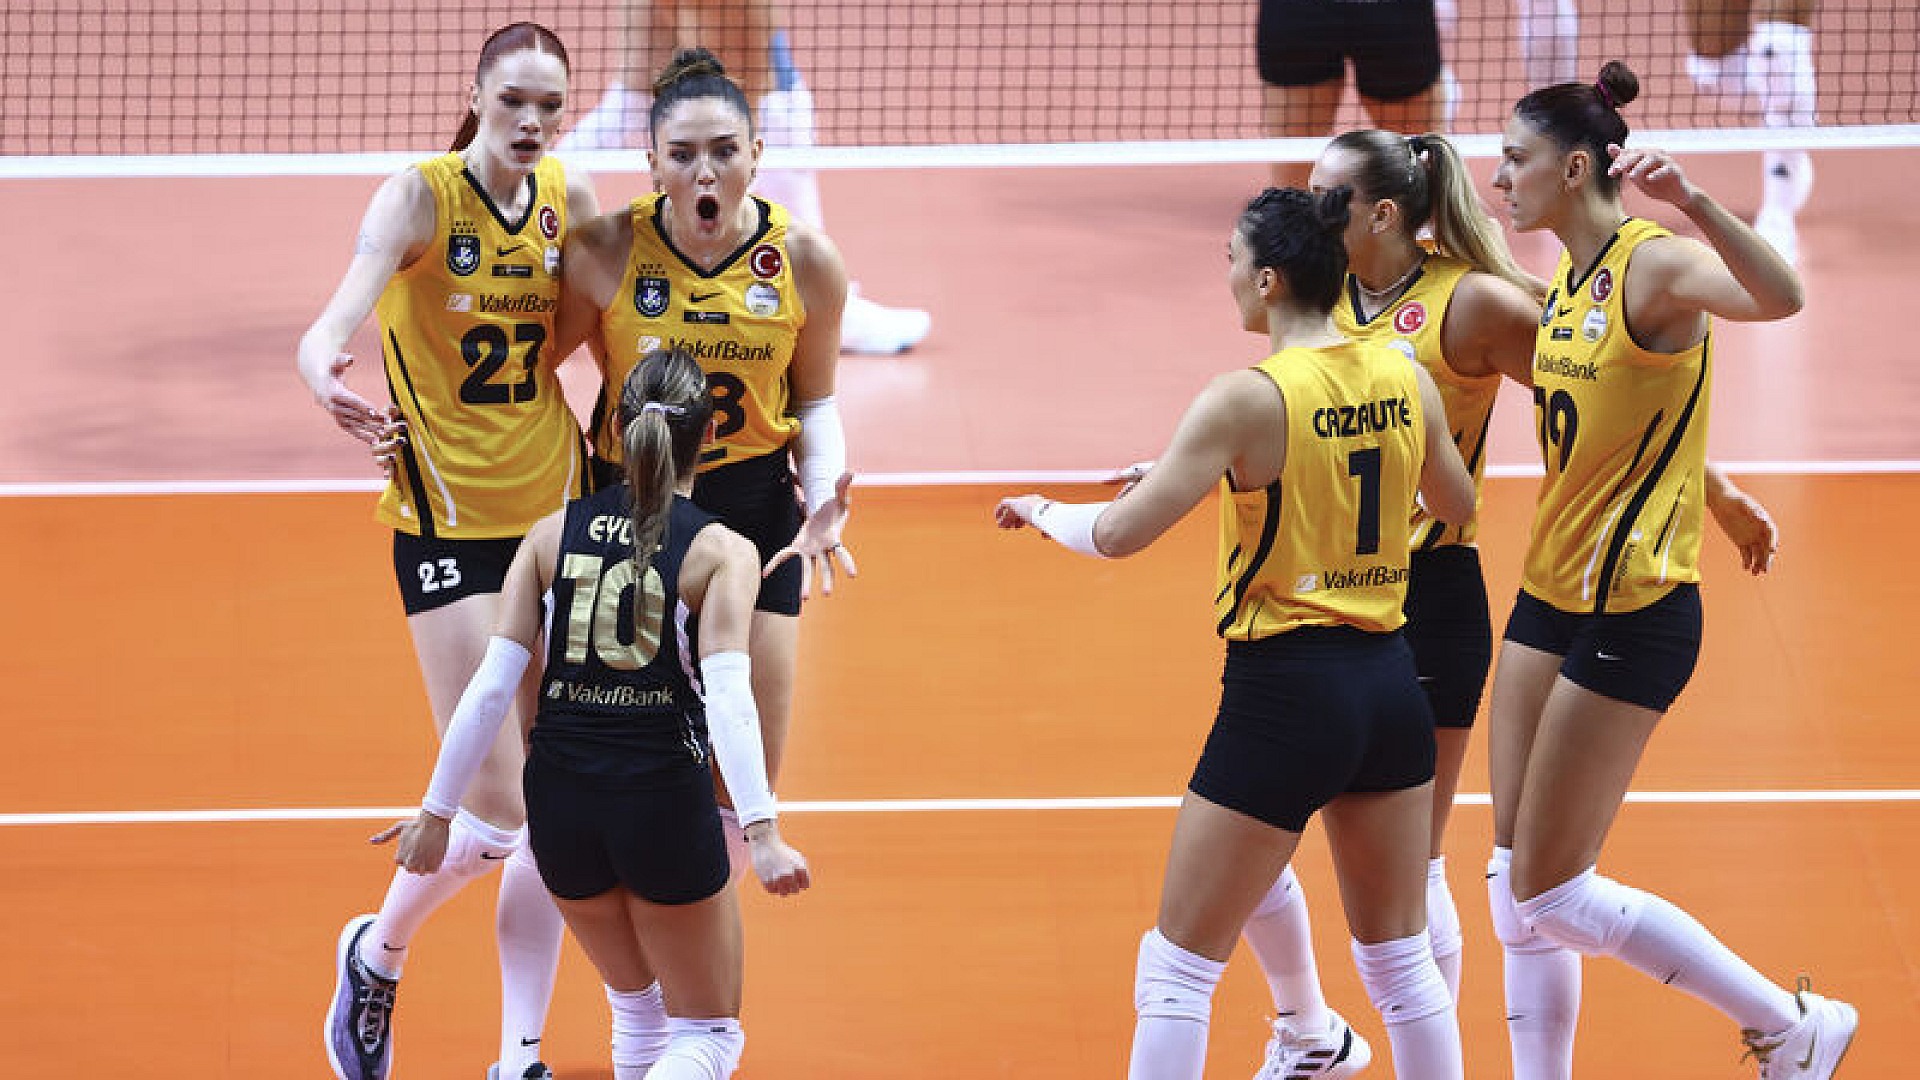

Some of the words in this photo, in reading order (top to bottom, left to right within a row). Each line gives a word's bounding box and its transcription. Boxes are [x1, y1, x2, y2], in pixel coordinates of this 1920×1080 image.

[480, 292, 556, 313] VakıfBan
[1313, 398, 1411, 437] CAZAUTE
[1349, 447, 1380, 555] 1
[418, 558, 461, 593] 23
[1325, 566, 1408, 588] VakıfBan
[561, 553, 666, 670] 10
